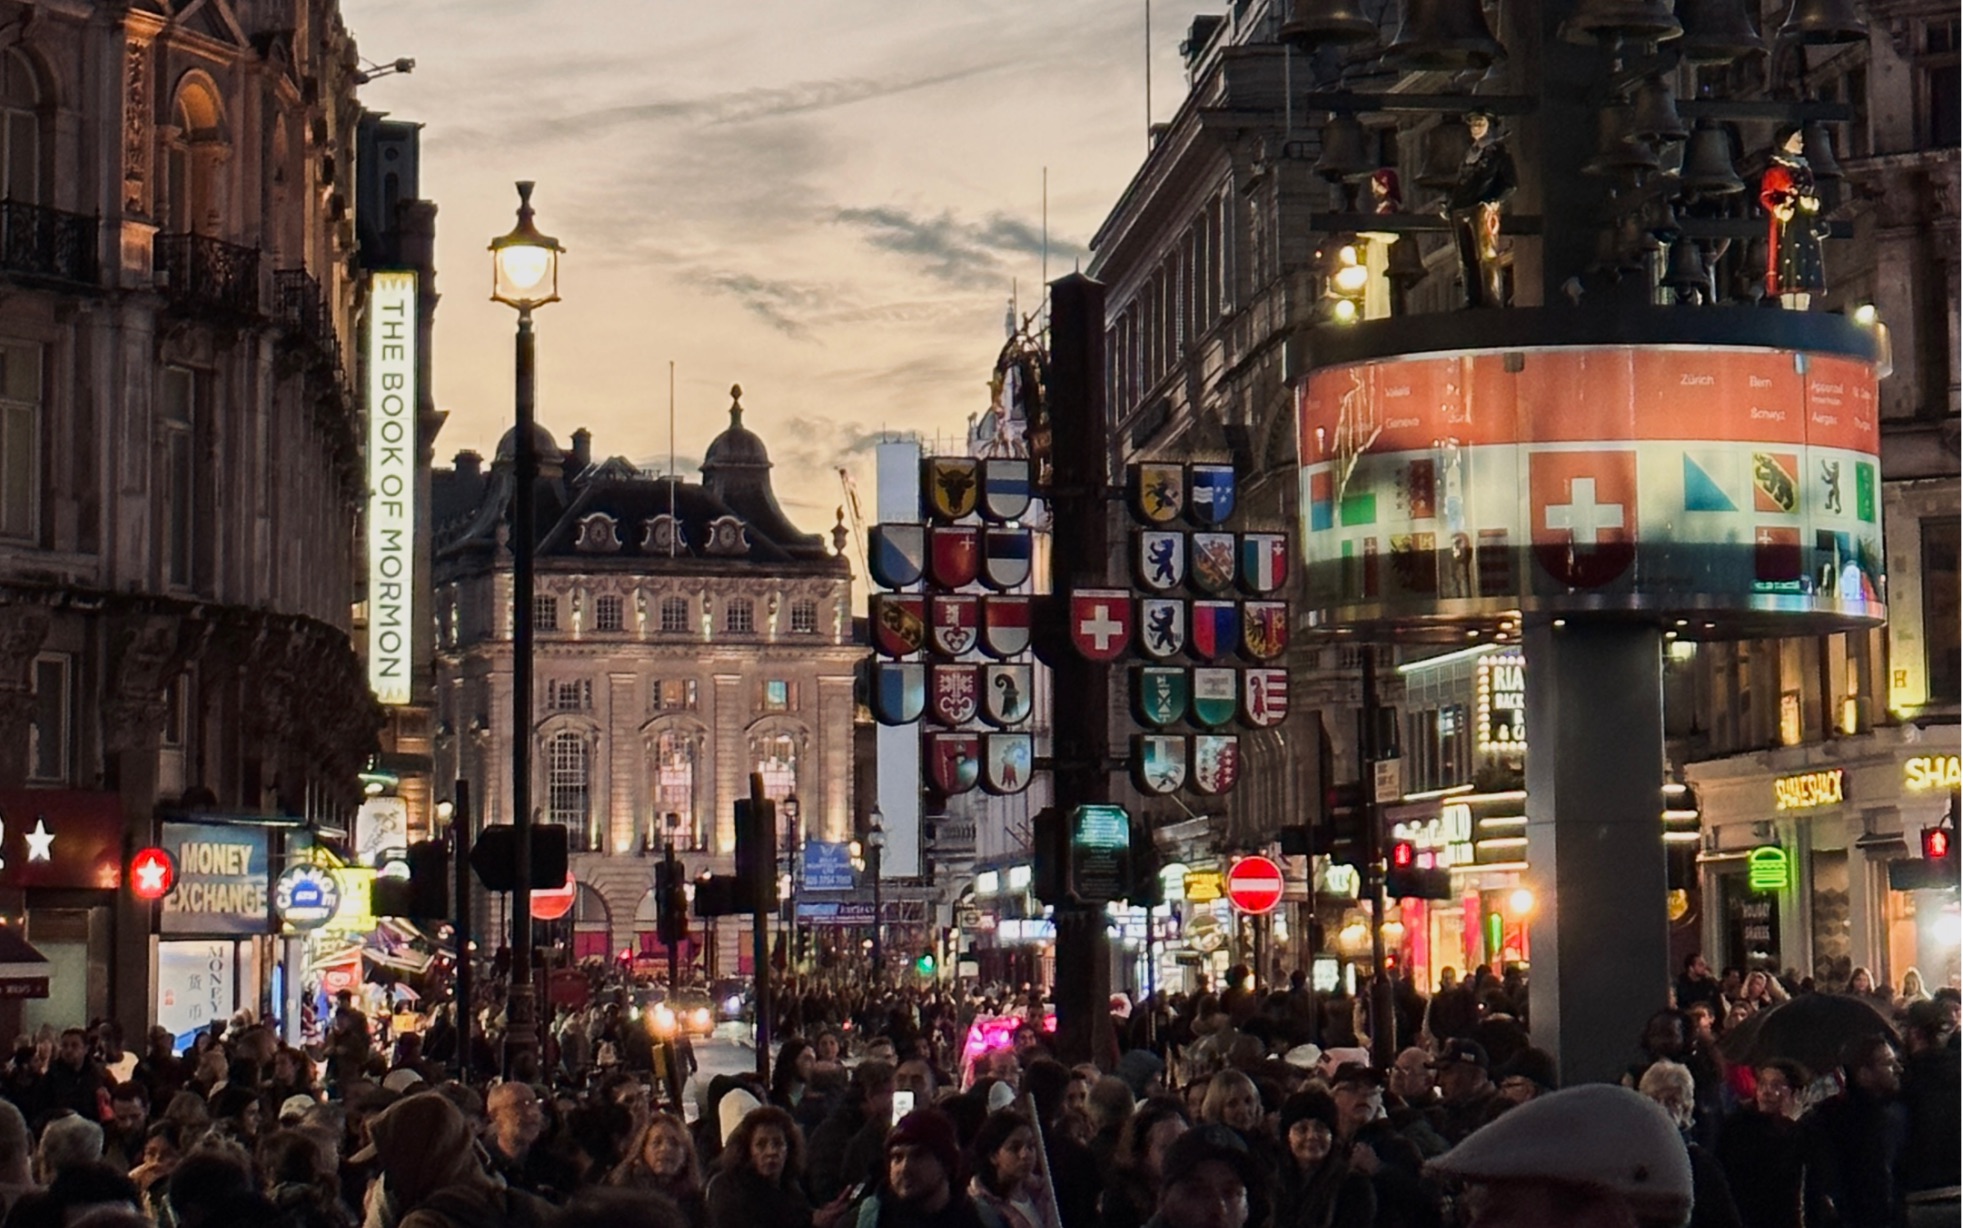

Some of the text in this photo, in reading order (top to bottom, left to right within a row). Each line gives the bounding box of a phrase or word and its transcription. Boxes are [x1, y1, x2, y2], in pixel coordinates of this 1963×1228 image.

[379, 299, 404, 678] THE BOOK OF MORMON
[181, 842, 253, 876] MONEY
[163, 882, 268, 918] EXCHANGE
[276, 867, 337, 909] CHANGE
